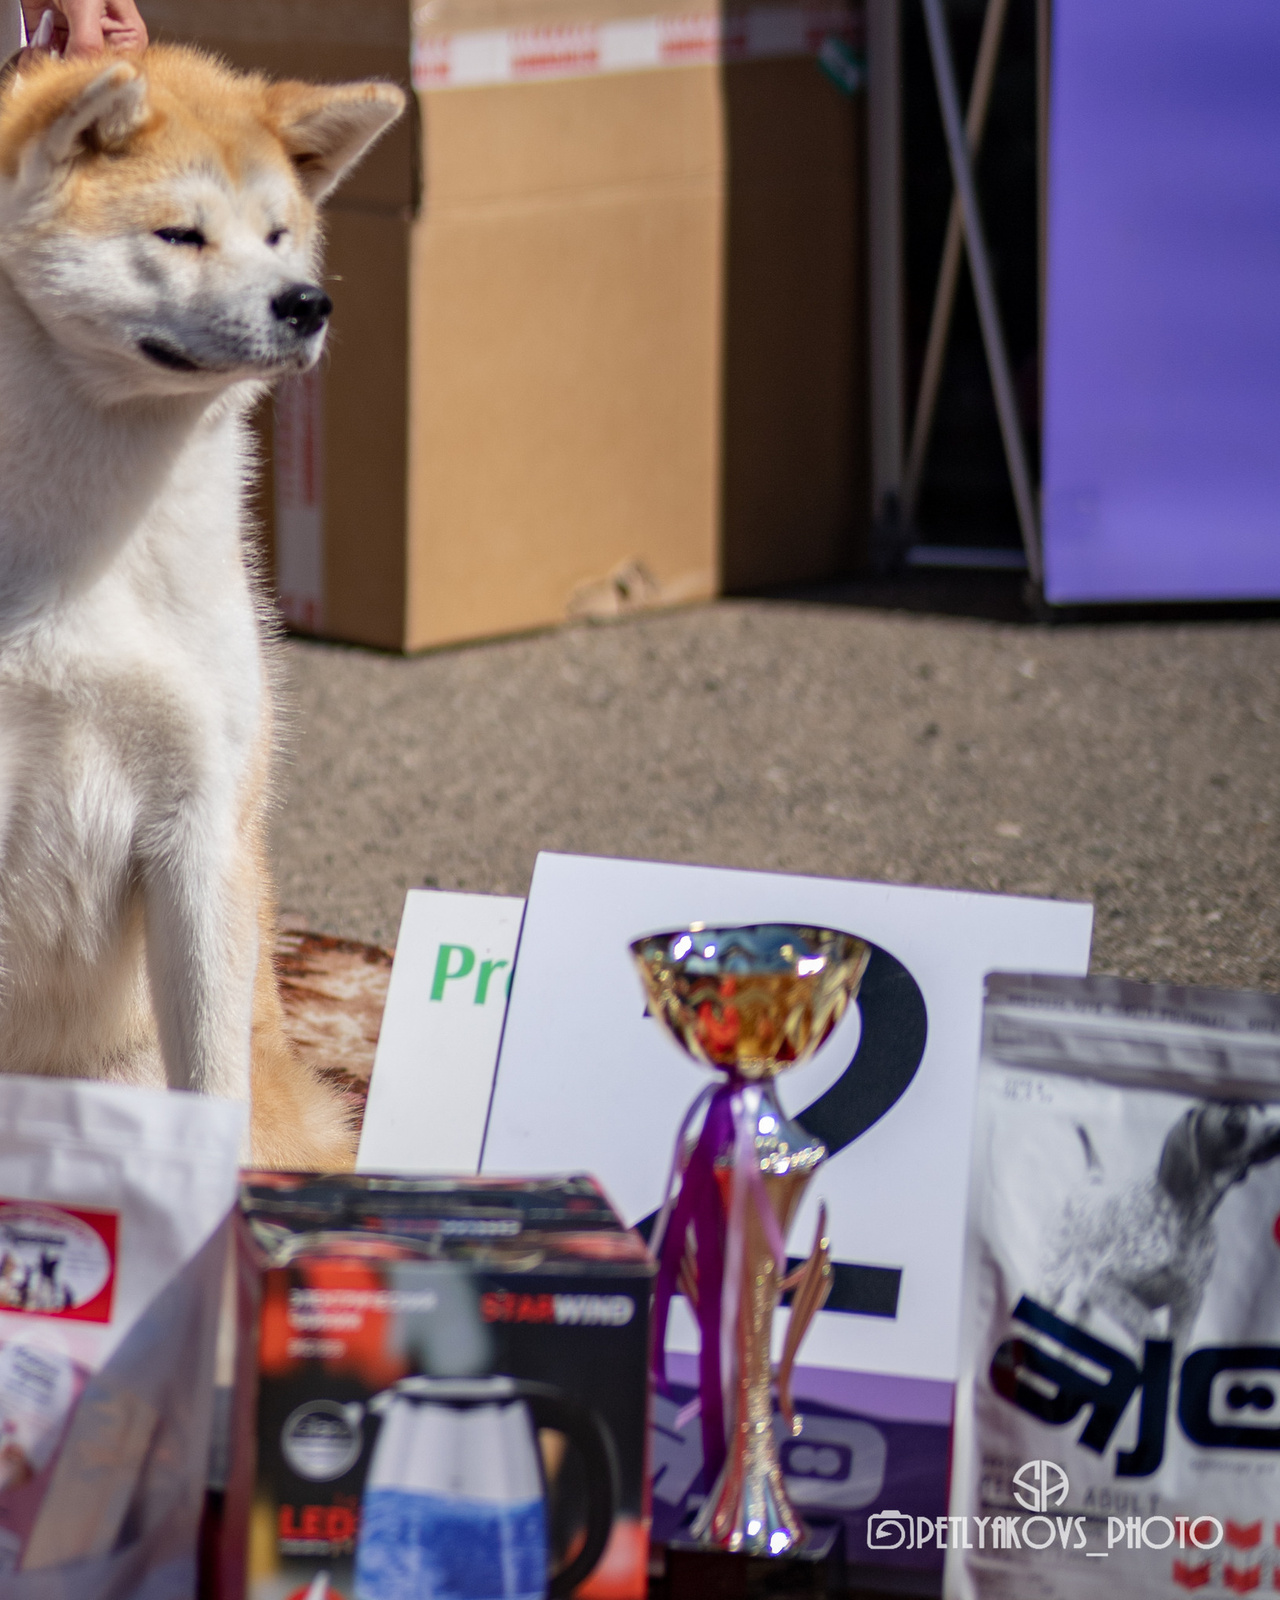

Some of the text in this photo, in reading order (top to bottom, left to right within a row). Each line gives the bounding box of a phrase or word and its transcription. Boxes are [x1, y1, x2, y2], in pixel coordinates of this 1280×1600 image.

[429, 943, 515, 1005] Pr
[482, 1292, 634, 1326] STARWIND
[279, 1504, 358, 1541] LED
